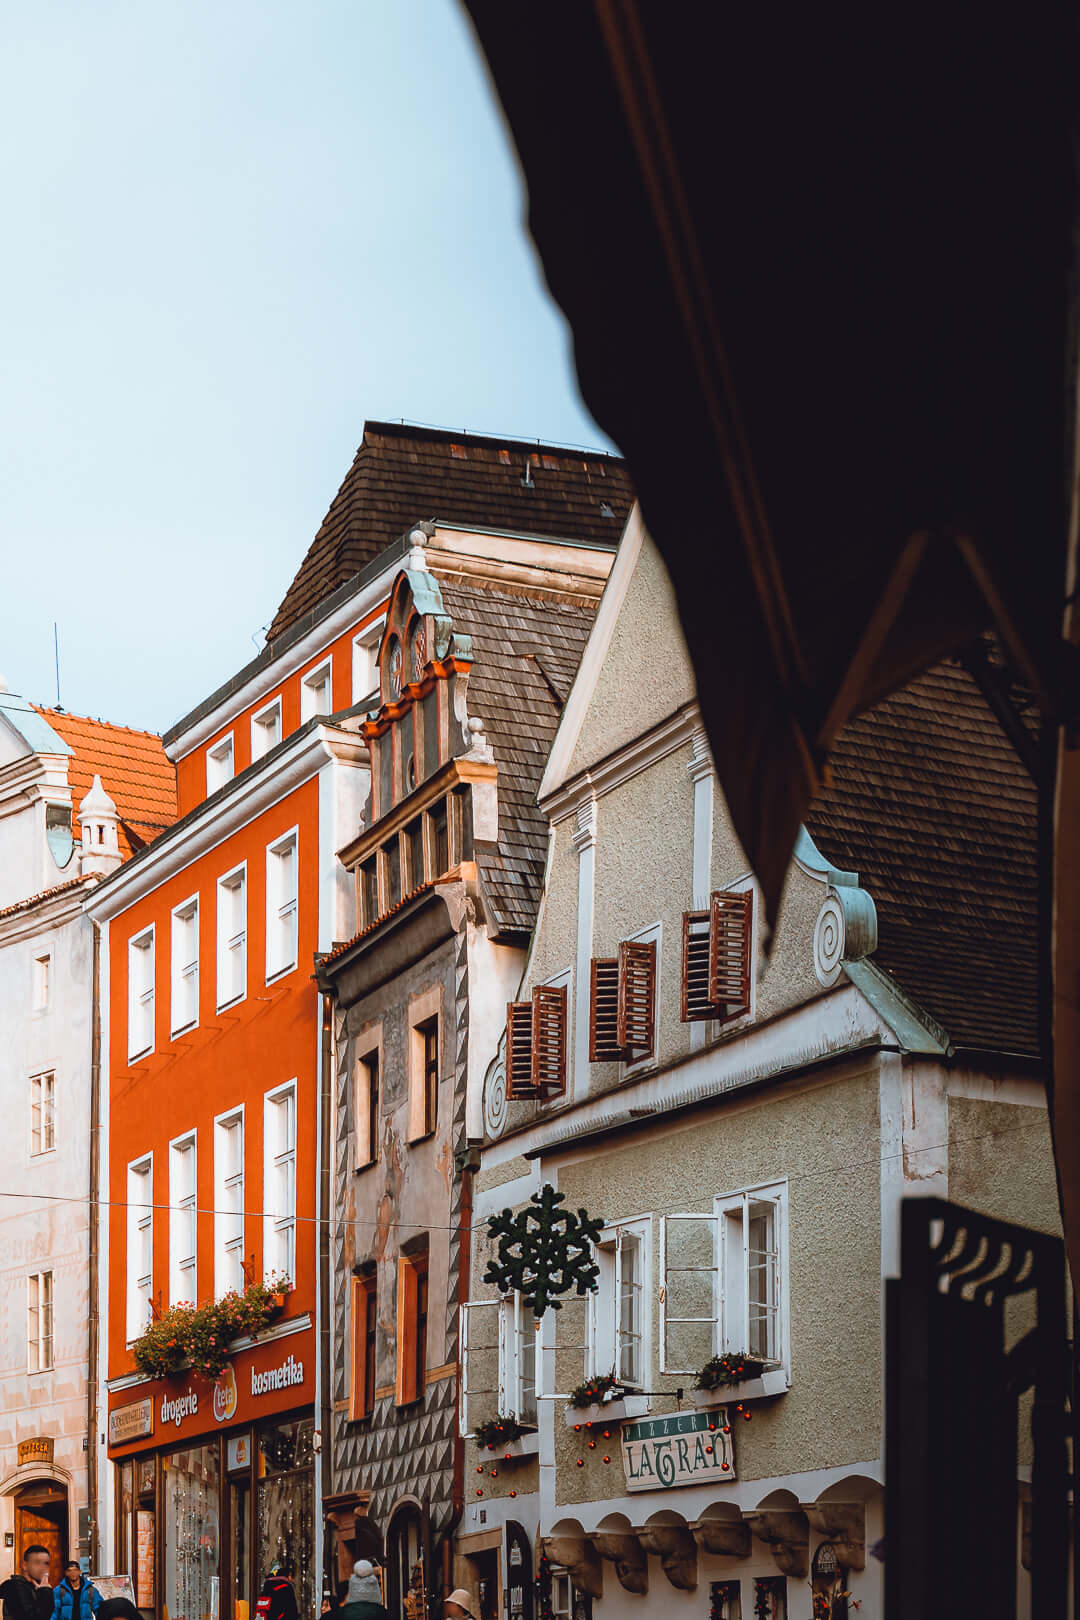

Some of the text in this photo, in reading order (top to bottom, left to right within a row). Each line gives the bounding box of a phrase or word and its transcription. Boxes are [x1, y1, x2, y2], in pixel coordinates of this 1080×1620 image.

[251, 1354, 304, 1396] kosmetika
[160, 1386, 199, 1427] drogerie
[217, 1385, 233, 1409] teta
[624, 1412, 725, 1441] PIZZERIA
